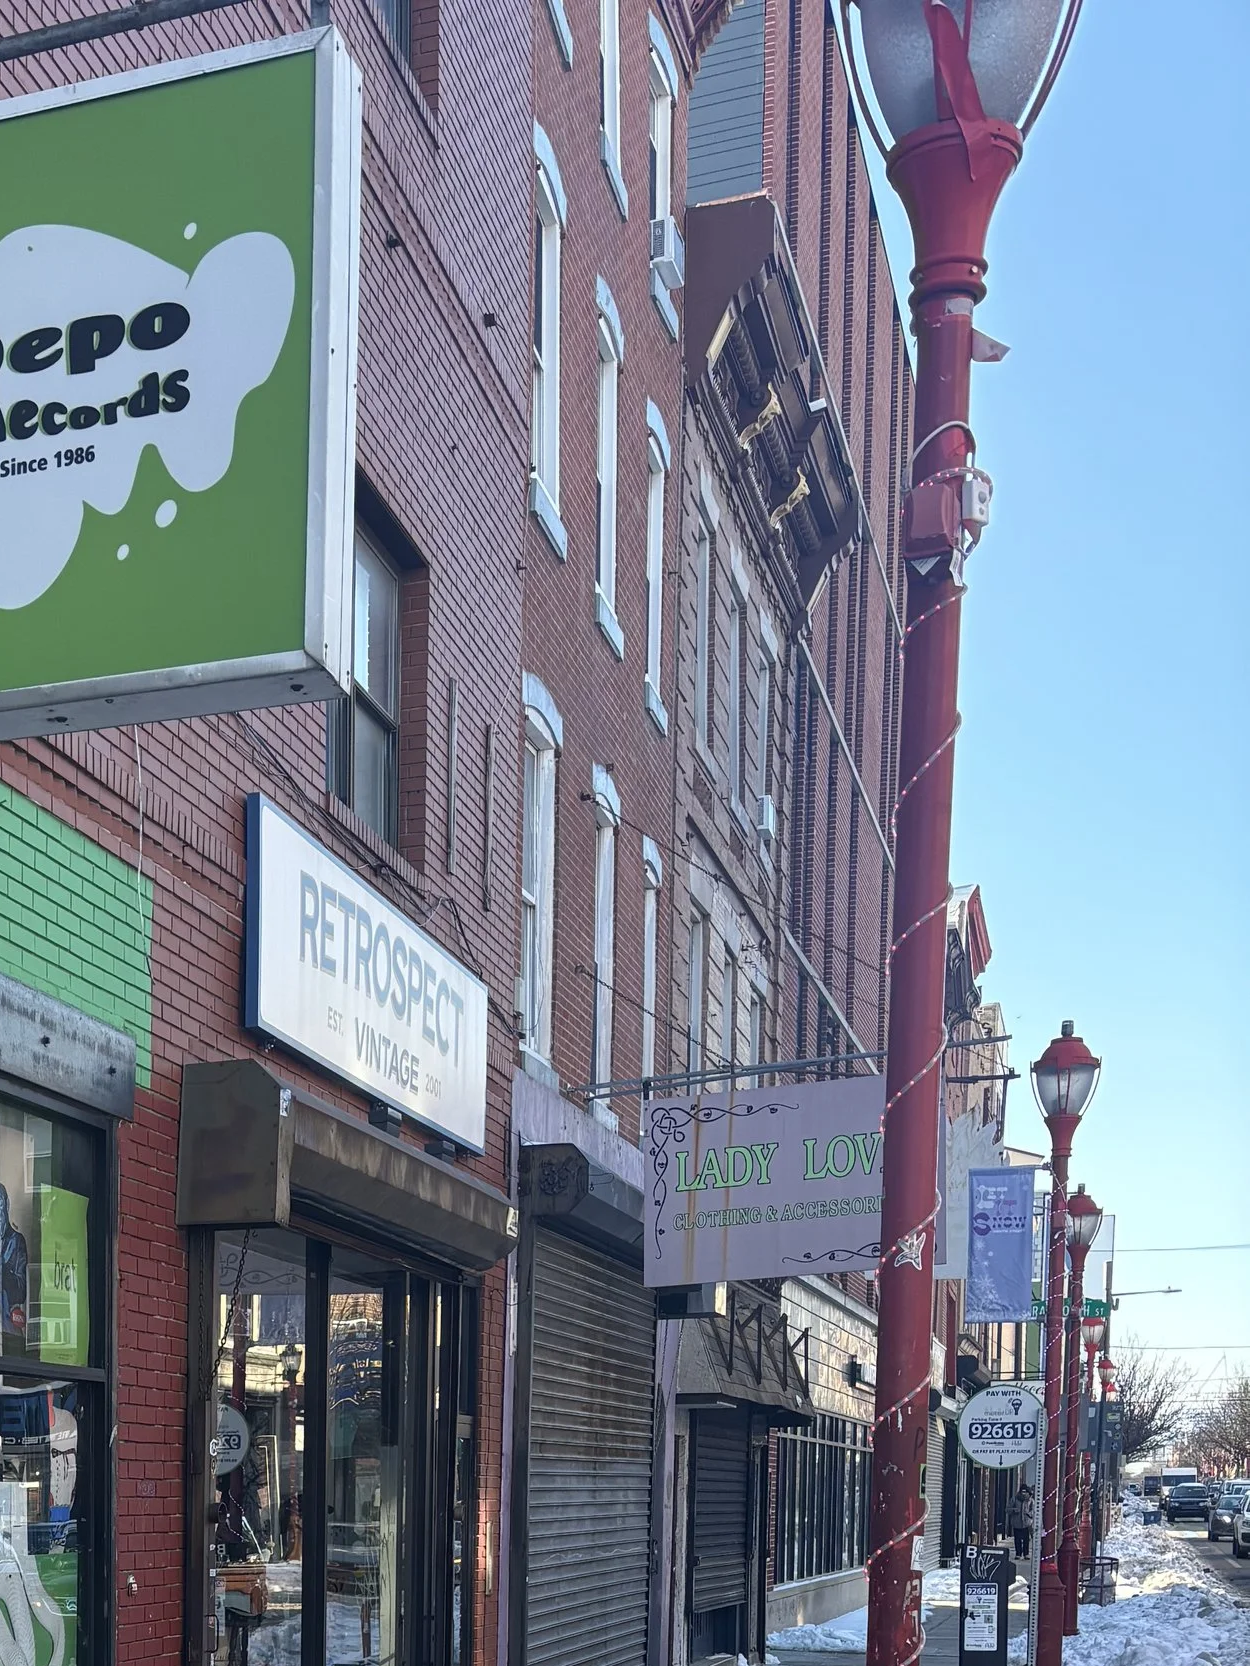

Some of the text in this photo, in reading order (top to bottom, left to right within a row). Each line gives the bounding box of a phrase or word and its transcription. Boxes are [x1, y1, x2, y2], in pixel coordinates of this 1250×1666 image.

[0, 445, 96, 478] Since 1986
[300, 869, 464, 1068] RETROSPECT
[354, 1017, 420, 1096] VINTAGE
[675, 1132, 884, 1192] LADY LOV
[673, 1195, 883, 1231] CLOTHING & ACCESSORI
[54, 1251, 77, 1293] brat
[971, 1423, 1034, 1439] 926619
[966, 1546, 978, 1558] B
[967, 1587, 996, 1595] 926619
